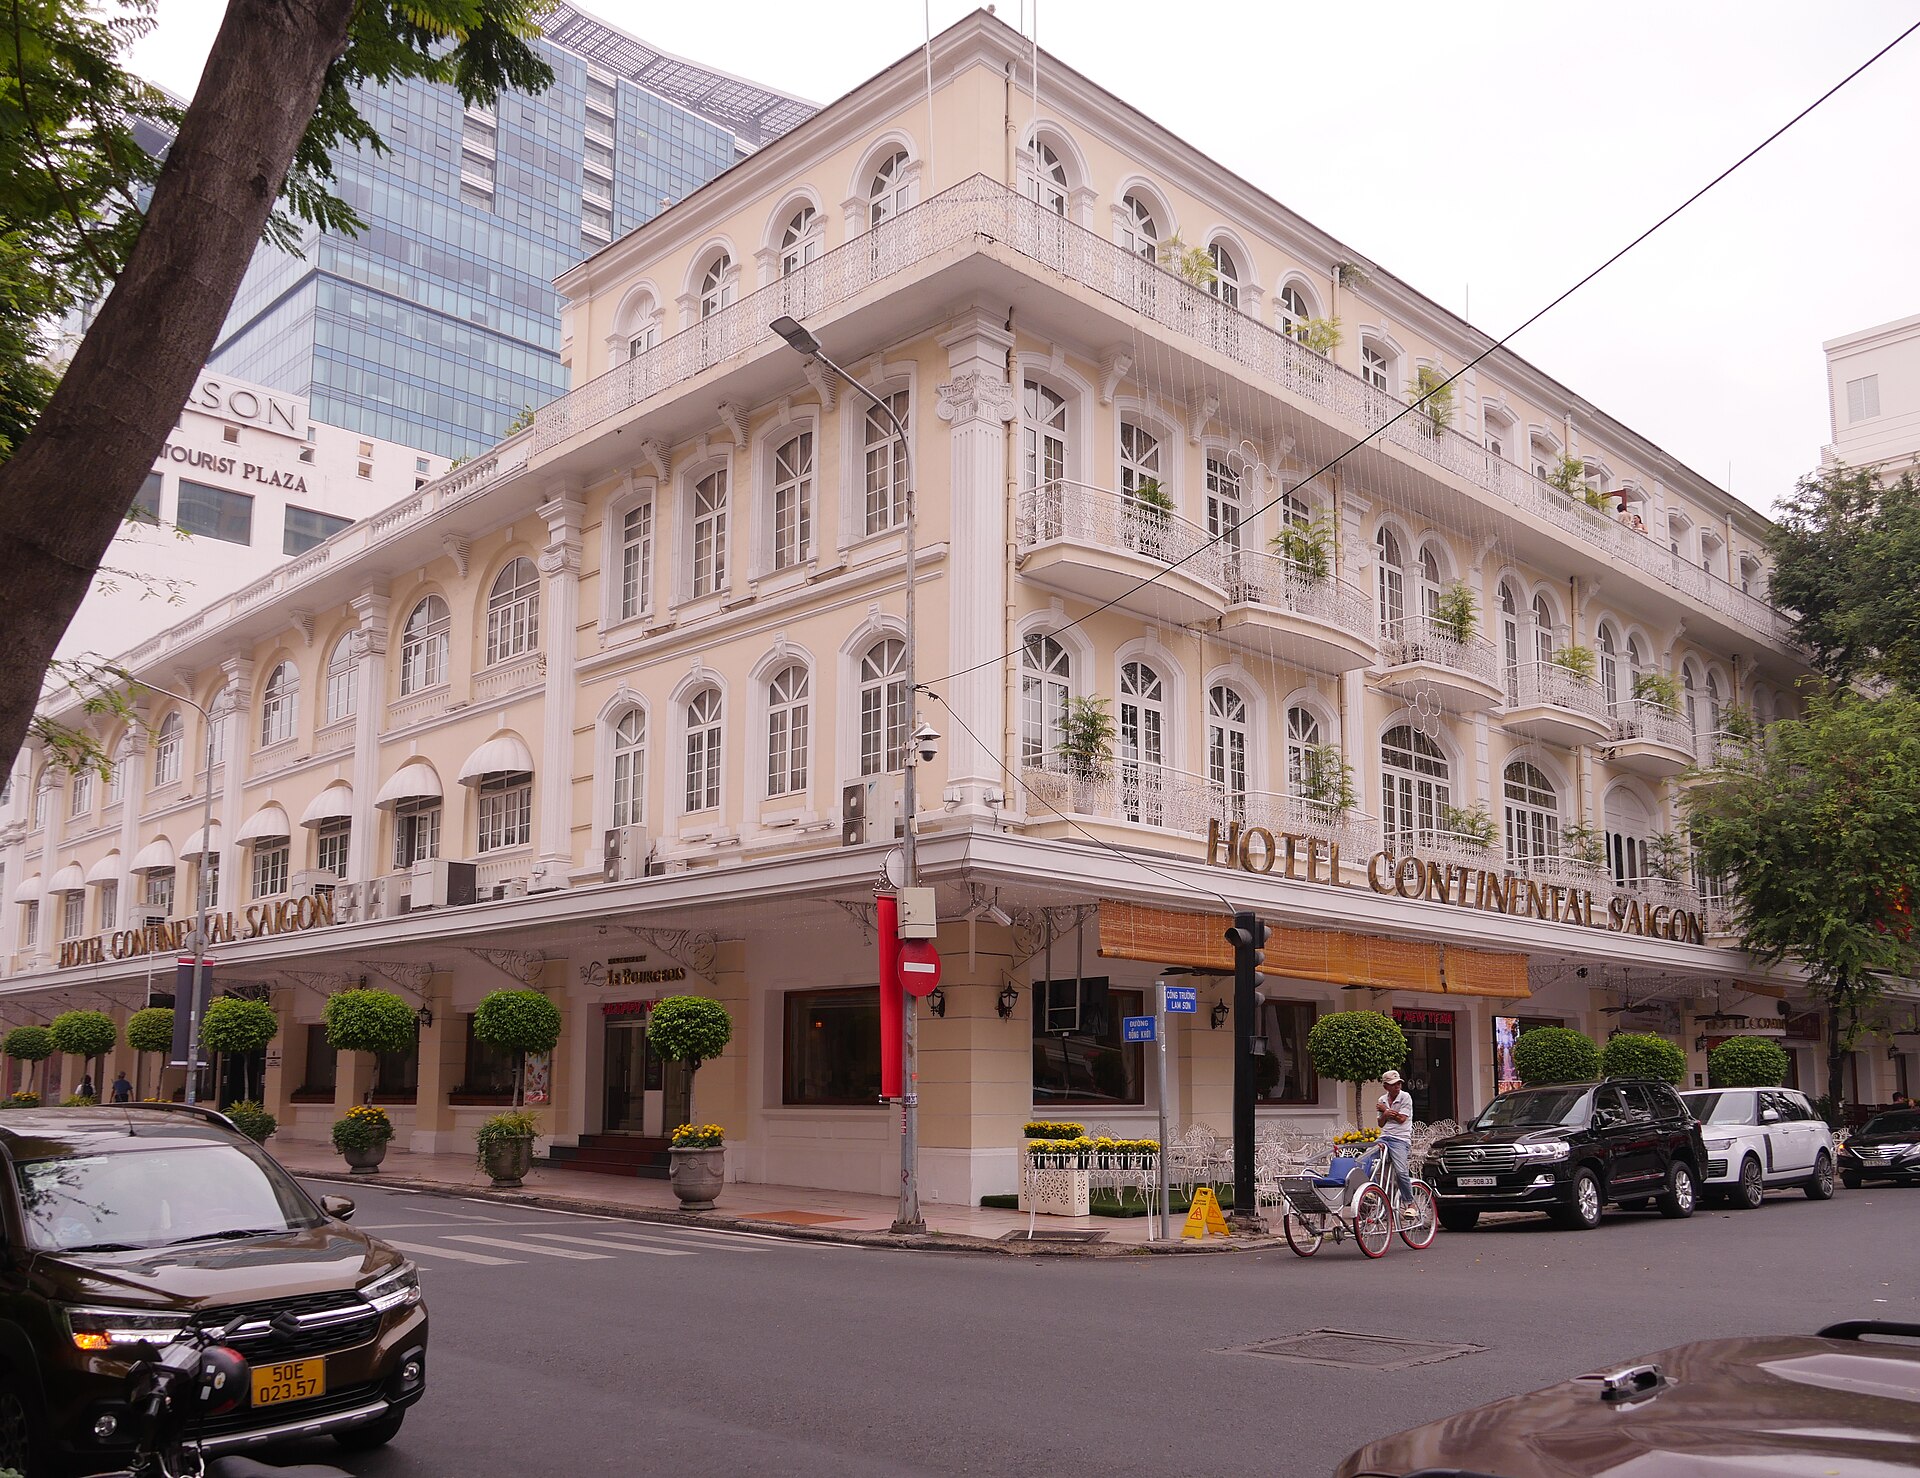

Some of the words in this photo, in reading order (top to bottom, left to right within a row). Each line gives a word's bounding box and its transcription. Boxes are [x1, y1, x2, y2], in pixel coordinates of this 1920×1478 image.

[189, 382, 297, 430] SON
[160, 442, 236, 475] TOURIST
[242, 462, 308, 493] PLAZA
[1206, 818, 1351, 888] HOTEL
[1367, 850, 1605, 929] CONTINENTAL
[1607, 896, 1705, 945] SAIGON
[58, 936, 105, 969] HOTEL
[111, 912, 236, 960] CONTINEAL
[245, 890, 336, 939] SAIGON
[602, 1001, 642, 1016] HAPPY
[1171, 1001, 1181, 1009] LAM
[1404, 1010, 1426, 1023] NEW
[1428, 1011, 1453, 1025] YEAR
[273, 1363, 304, 1382] 50E
[260, 1378, 317, 1403] 023.57
